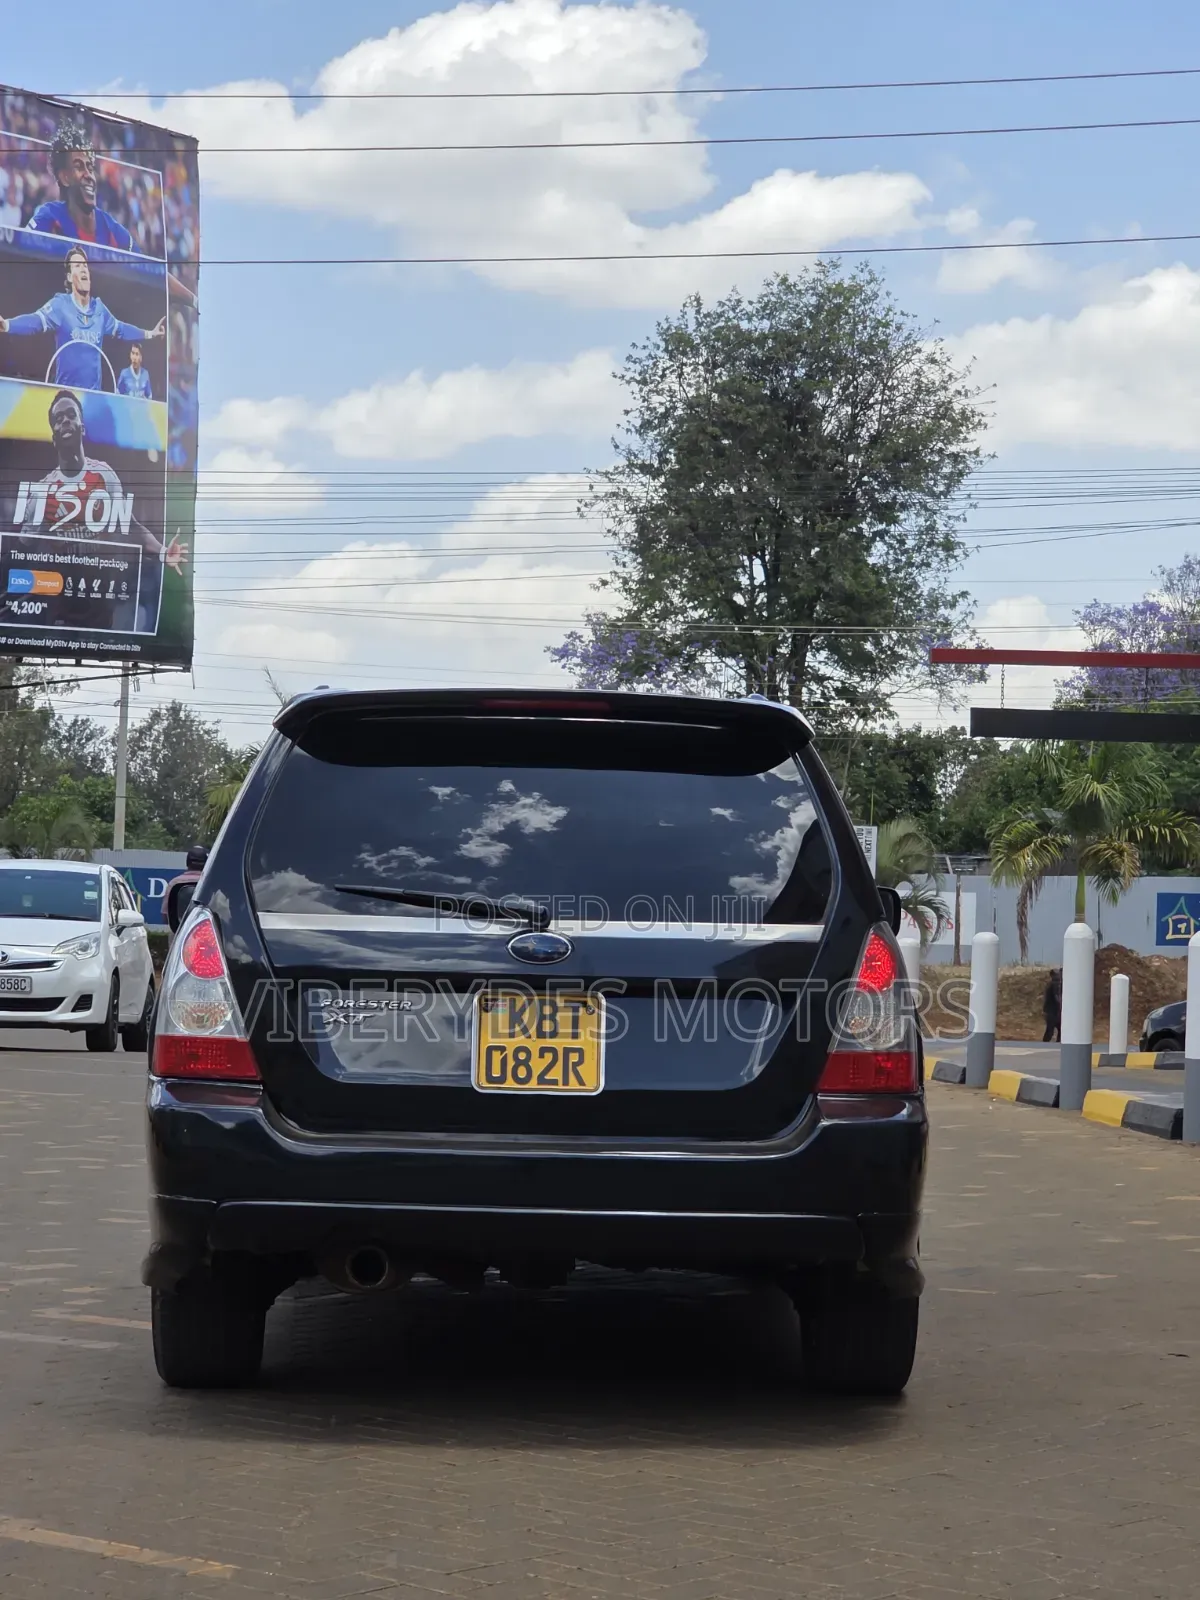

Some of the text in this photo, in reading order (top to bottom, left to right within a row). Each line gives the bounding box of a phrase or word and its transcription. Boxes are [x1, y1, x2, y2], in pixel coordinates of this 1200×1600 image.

[13, 481, 134, 535] IT'S ON
[11, 550, 129, 571] The world's best football package
[36, 579, 60, 588] Compact
[11, 600, 42, 615] 4,200
[15, 637, 45, 647] Download
[45, 639, 68, 649] MyDStv
[68, 641, 80, 650] App
[86, 641, 99, 651] stay
[99, 642, 126, 651] Connected
[0, 978, 27, 991] 858C
[320, 999, 413, 1012] FORESTER
[322, 1011, 375, 1025] XT
[508, 997, 588, 1040] KBT
[485, 1044, 587, 1087] 082R
